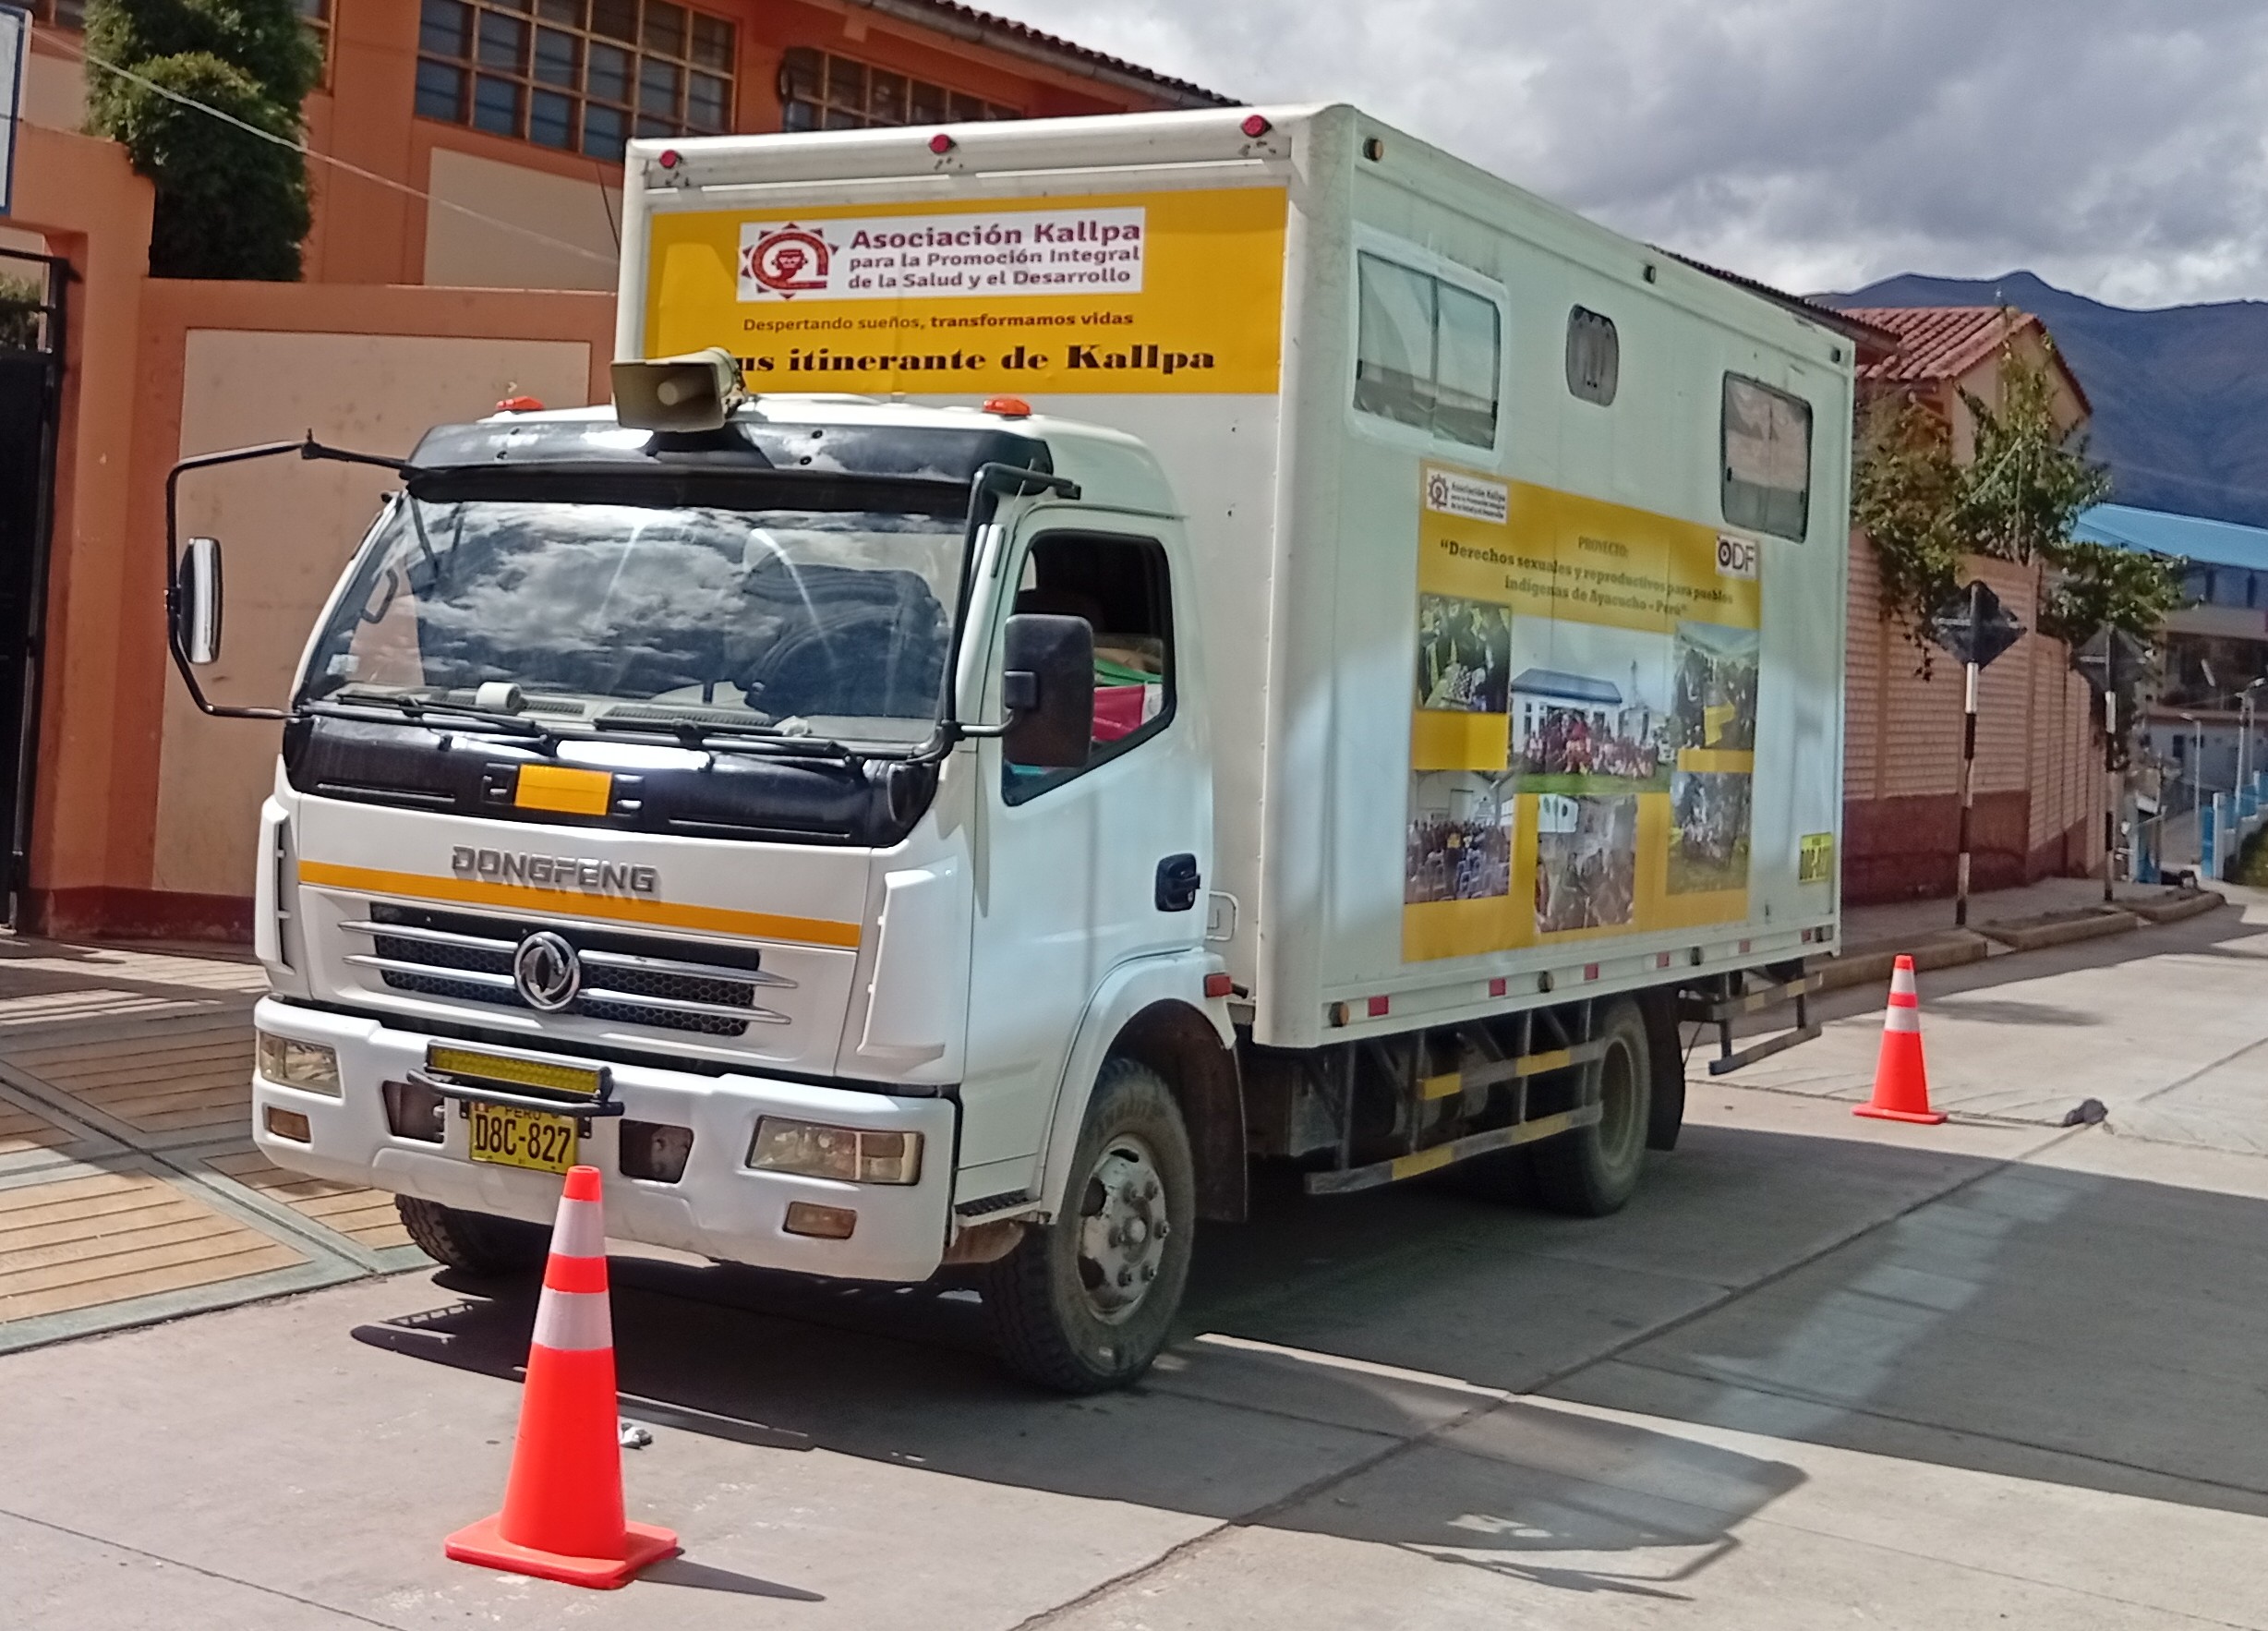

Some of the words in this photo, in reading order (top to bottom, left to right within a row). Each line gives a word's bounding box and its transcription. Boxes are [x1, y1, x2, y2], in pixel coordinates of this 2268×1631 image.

[850, 224, 1022, 249] Asociación
[1034, 221, 1140, 247] Kallpa
[850, 255, 895, 272] para
[900, 252, 920, 267] la
[927, 248, 1043, 267] Promoción
[1050, 246, 1140, 265] Integral
[848, 275, 872, 289] de
[878, 273, 897, 288] la
[902, 272, 962, 288] Salud
[969, 272, 981, 289] y
[986, 271, 1006, 285] el
[1013, 267, 1131, 285] Desarrollo
[743, 317, 853, 333] Despertando
[858, 315, 925, 331] sueños,
[931, 312, 1076, 328] transformamos
[1081, 311, 1134, 326] vidas
[737, 356, 775, 372] us
[790, 347, 986, 372] itinerante
[1001, 345, 1049, 370] de
[1066, 344, 1215, 375] Kallpa
[1516, 558, 1572, 575] sexuales
[1574, 566, 1584, 580] y
[1584, 568, 1666, 593] reproductivos
[1667, 584, 1693, 598] para
[1693, 587, 1733, 604] pueblos
[1572, 587, 1587, 601] de
[1589, 589, 1647, 610] Ayacucho
[452, 843, 657, 893] DONGFENG
[475, 1113, 572, 1164] D8C-827
